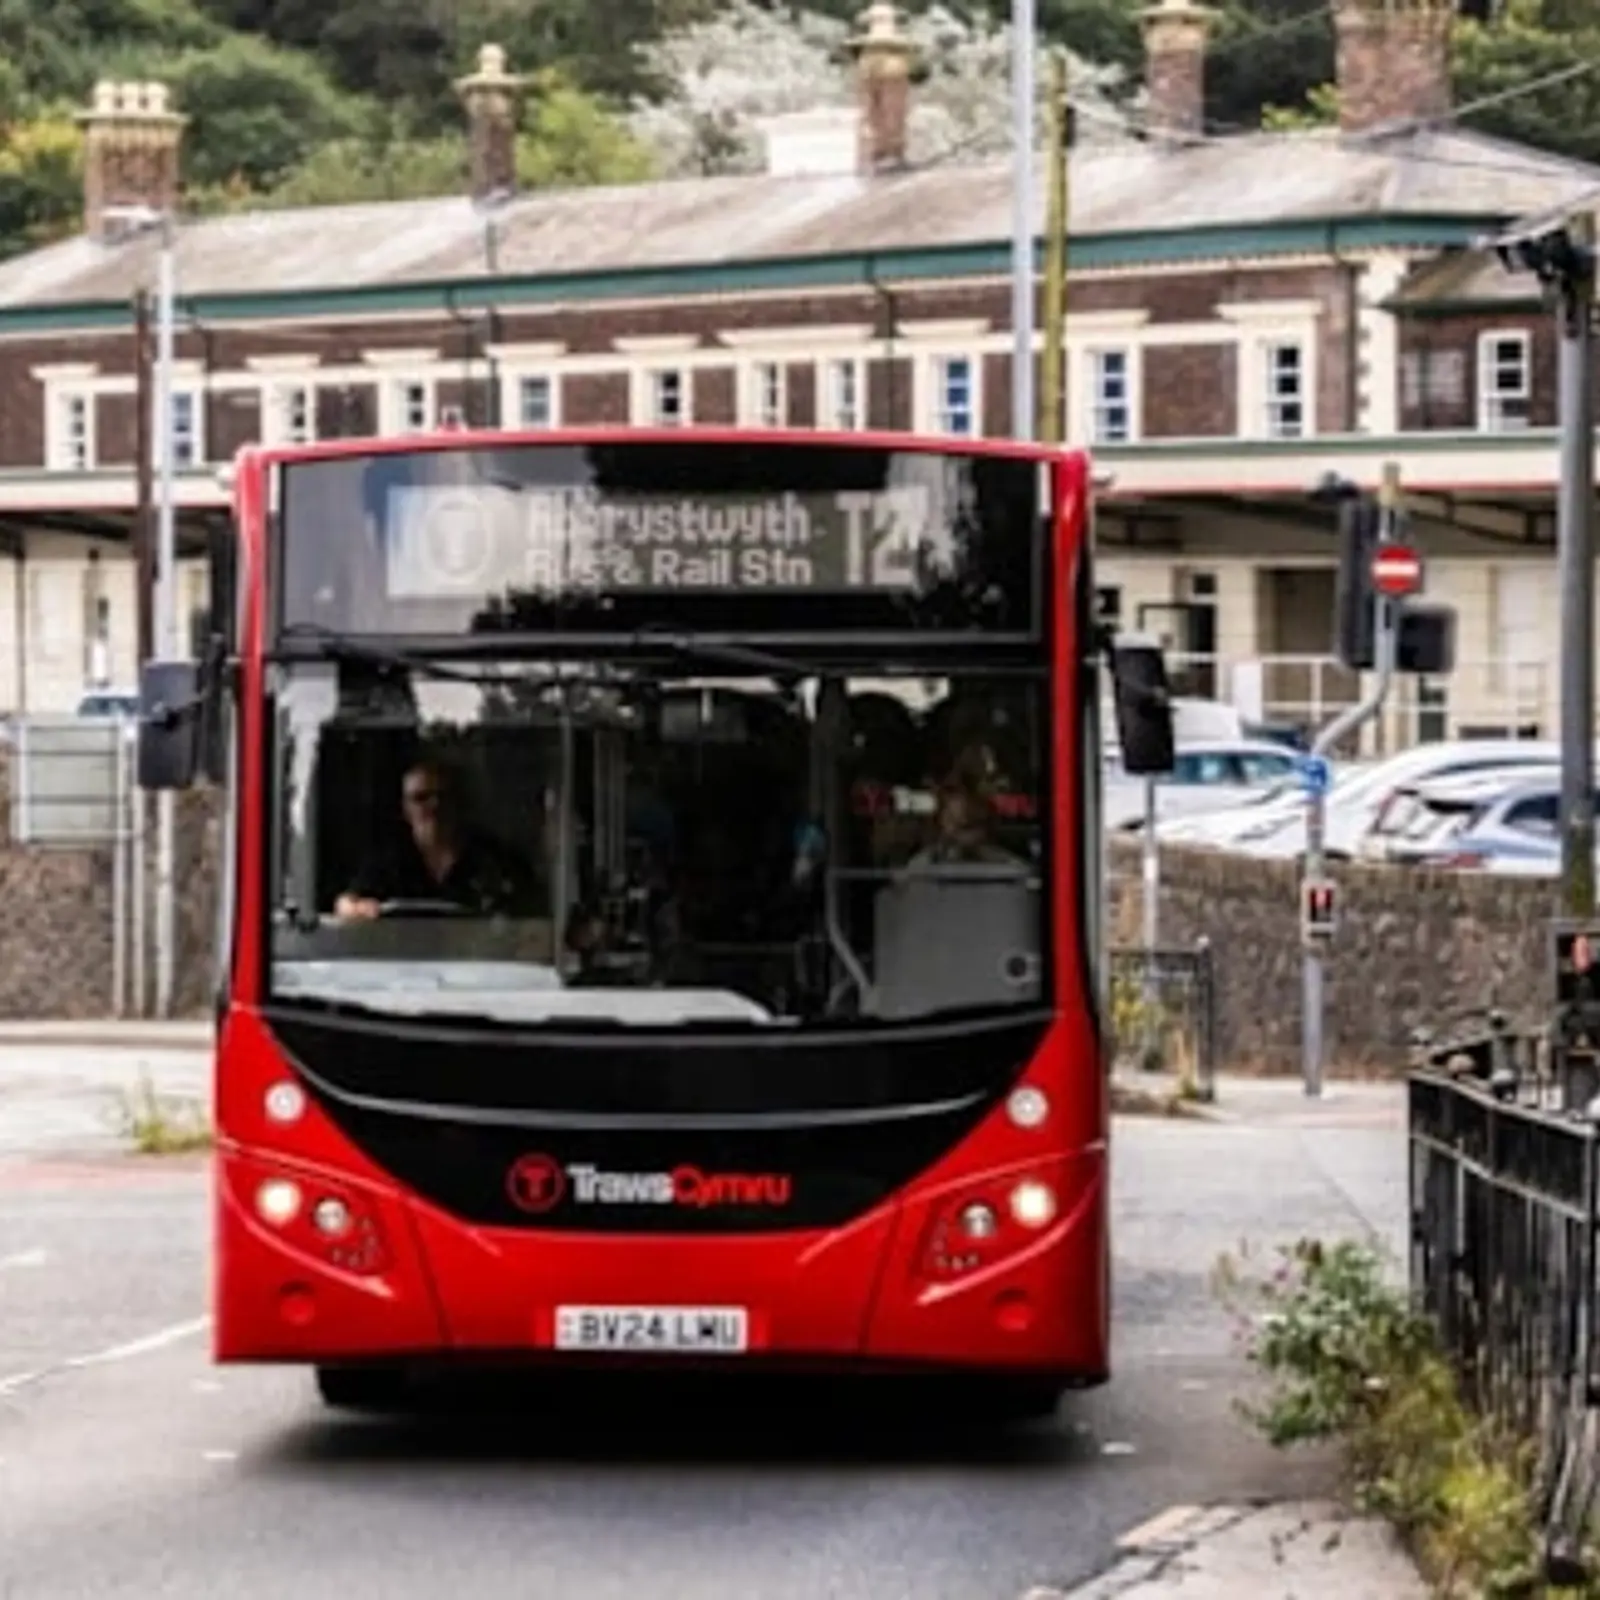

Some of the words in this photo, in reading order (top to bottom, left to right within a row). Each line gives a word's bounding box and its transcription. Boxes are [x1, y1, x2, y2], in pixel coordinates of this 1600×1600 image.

[652, 549, 728, 585] Rail
[740, 549, 812, 585] Stn
[579, 1313, 666, 1345] BV24
